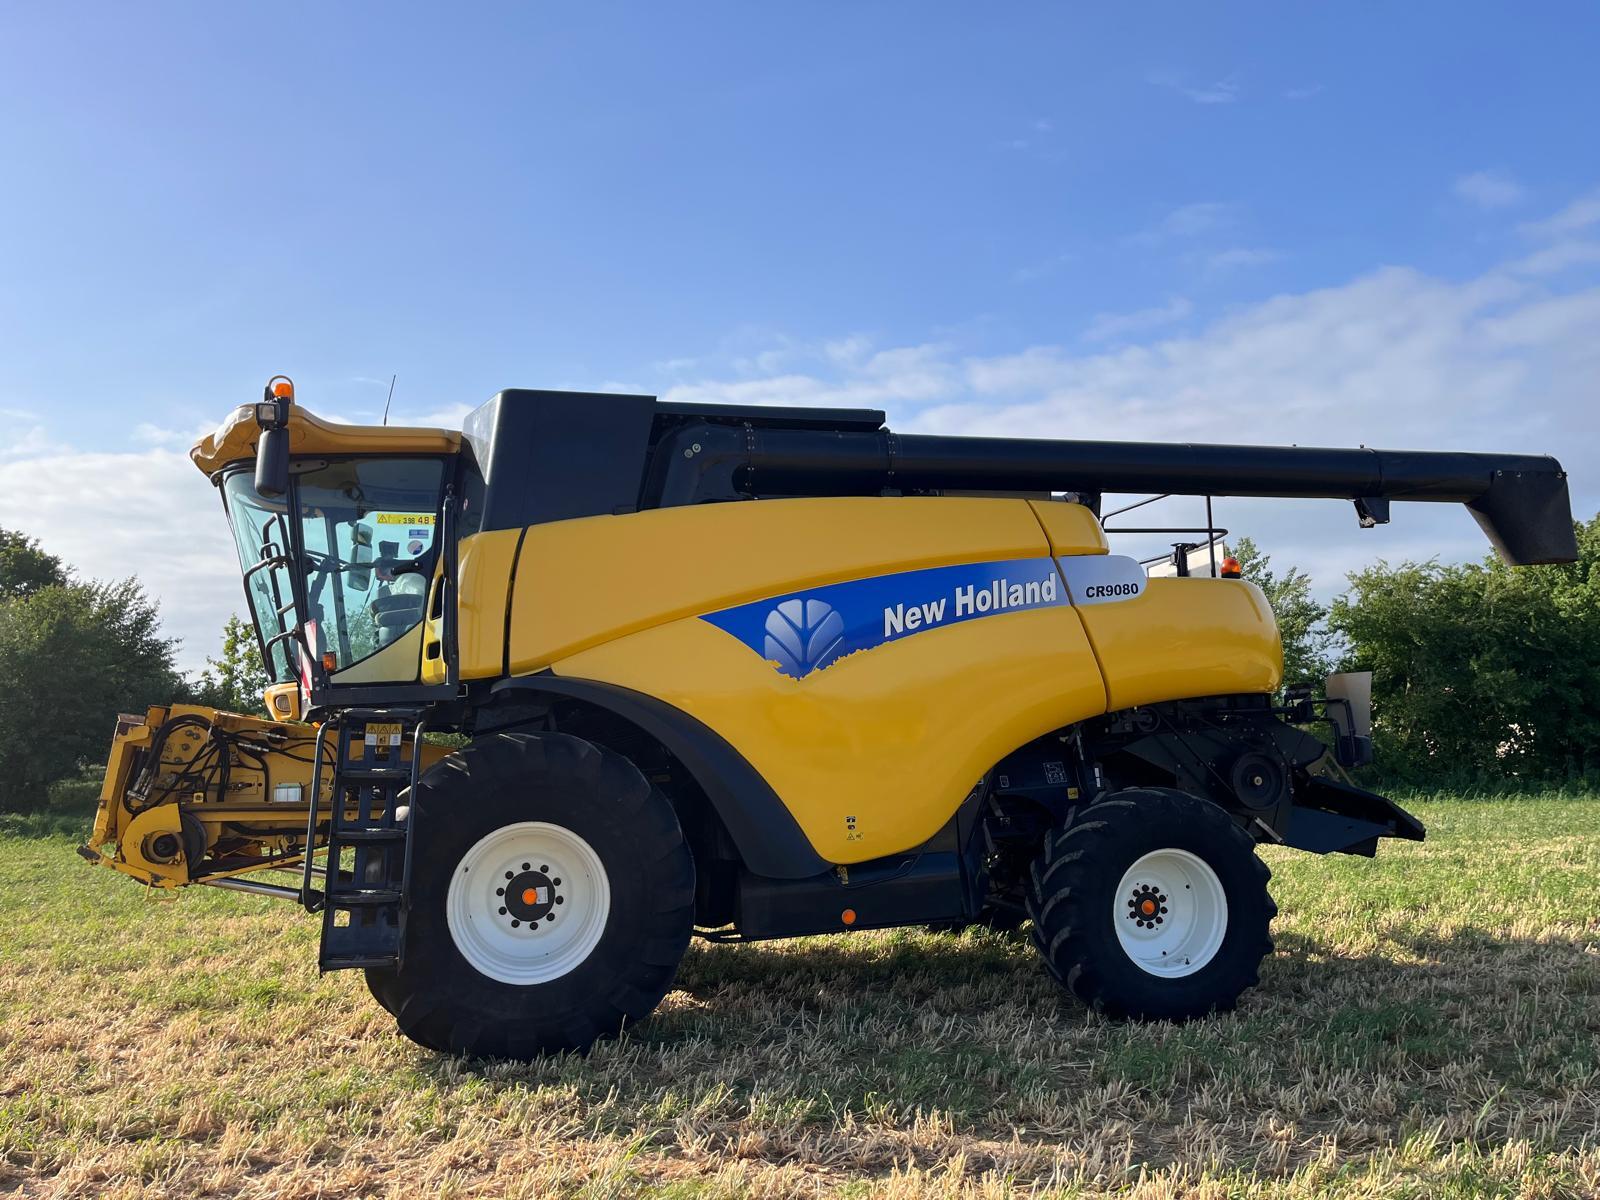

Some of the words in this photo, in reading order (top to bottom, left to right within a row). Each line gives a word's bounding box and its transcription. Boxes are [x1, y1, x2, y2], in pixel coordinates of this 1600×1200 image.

[884, 598, 946, 637] New
[956, 573, 1056, 616] Holland
[1086, 583, 1138, 598] CR9080
